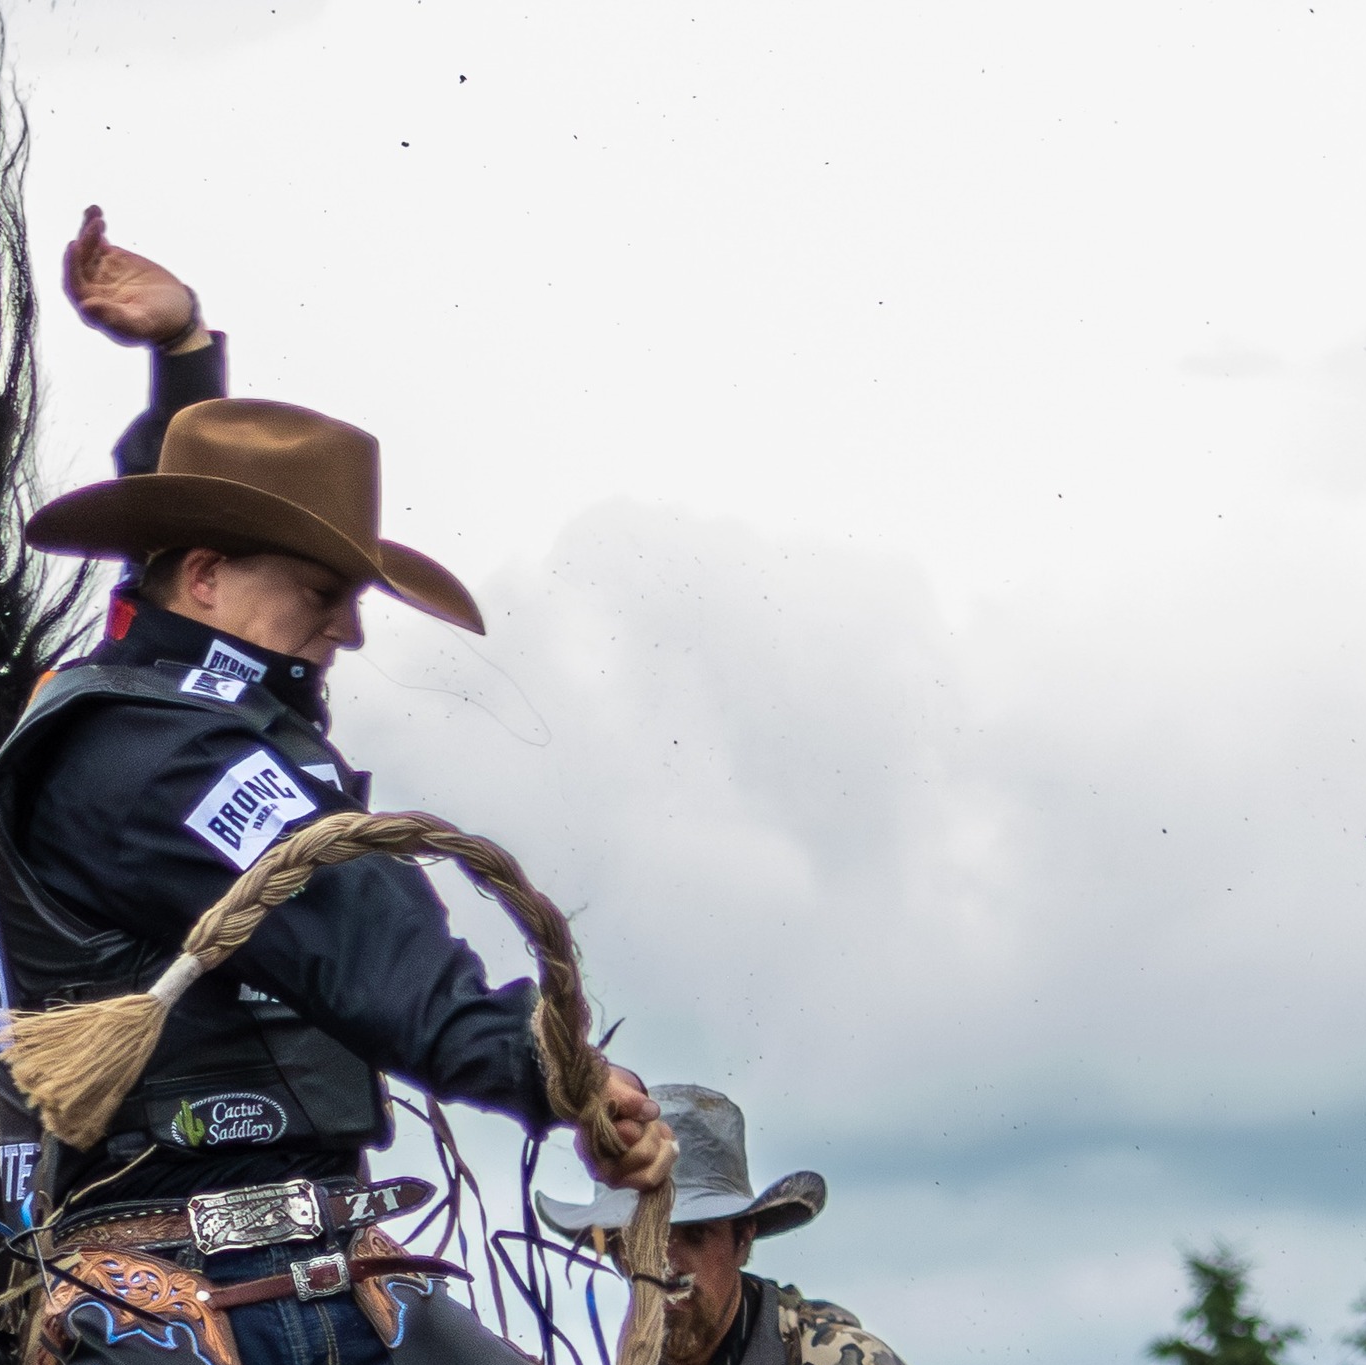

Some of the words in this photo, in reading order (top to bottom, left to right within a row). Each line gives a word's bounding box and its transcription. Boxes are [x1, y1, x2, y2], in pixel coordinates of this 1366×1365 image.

[207, 768, 297, 851] BRONC
[212, 1102, 263, 1124] Cactus
[206, 1119, 273, 1144] Saddlery
[345, 1186, 401, 1222] ZT
